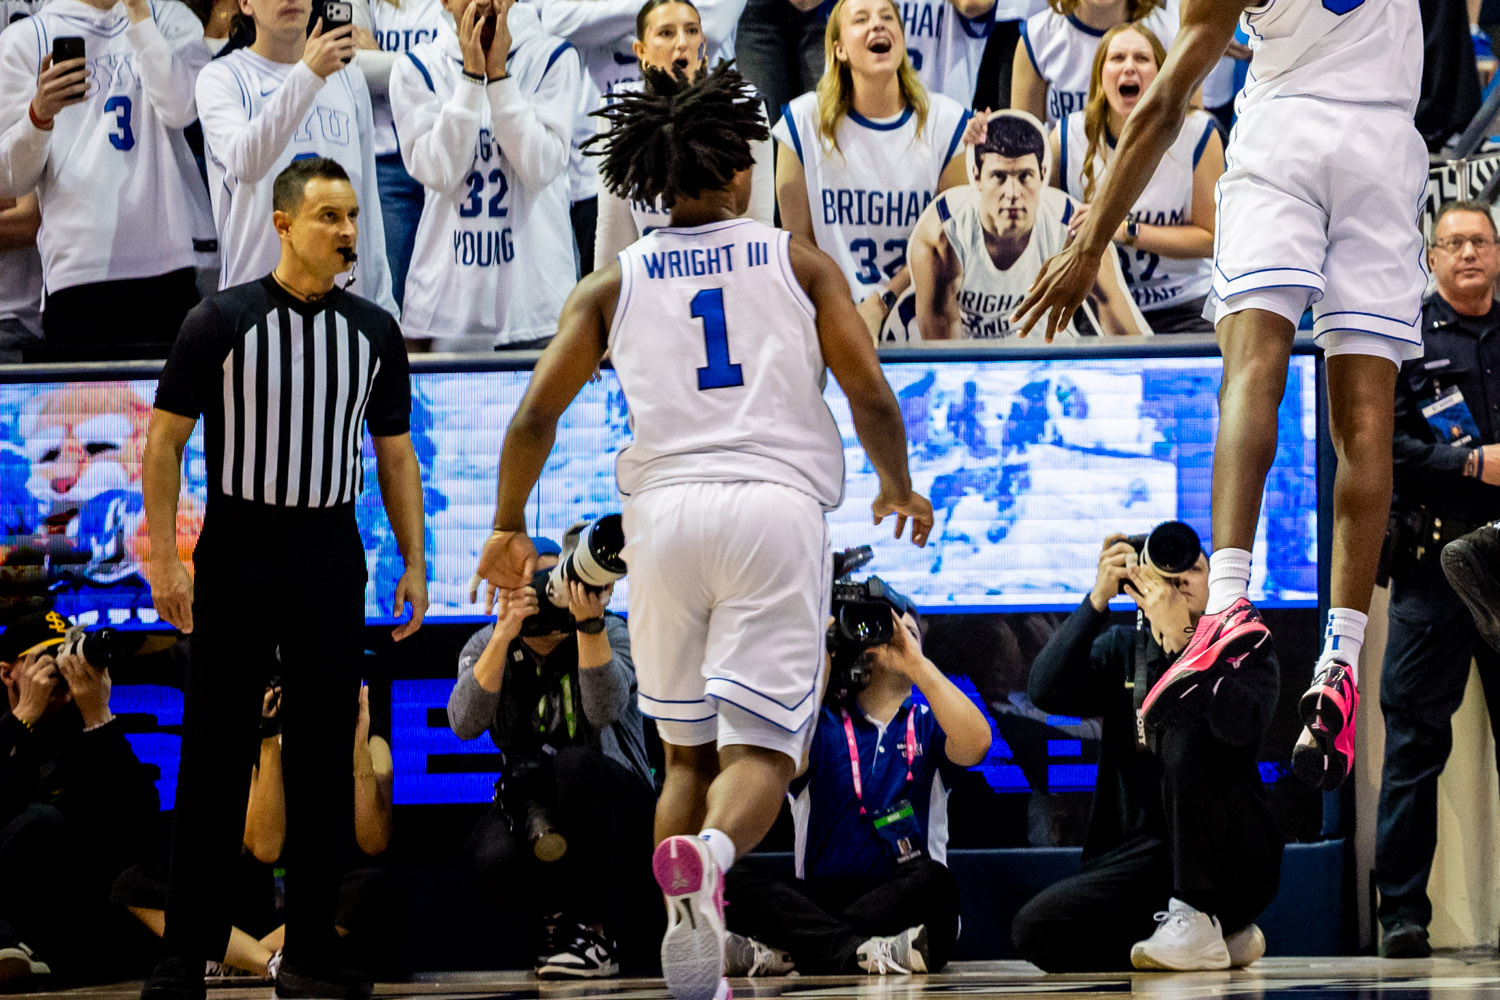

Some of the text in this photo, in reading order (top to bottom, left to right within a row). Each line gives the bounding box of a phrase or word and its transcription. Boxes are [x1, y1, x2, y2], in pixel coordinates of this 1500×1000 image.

[104, 96, 135, 151] 3
[459, 169, 508, 217] 32
[453, 227, 515, 267] YOUNG
[643, 241, 769, 280] WRIGHT III
[850, 238, 908, 284] 32
[690, 288, 743, 389] 1
